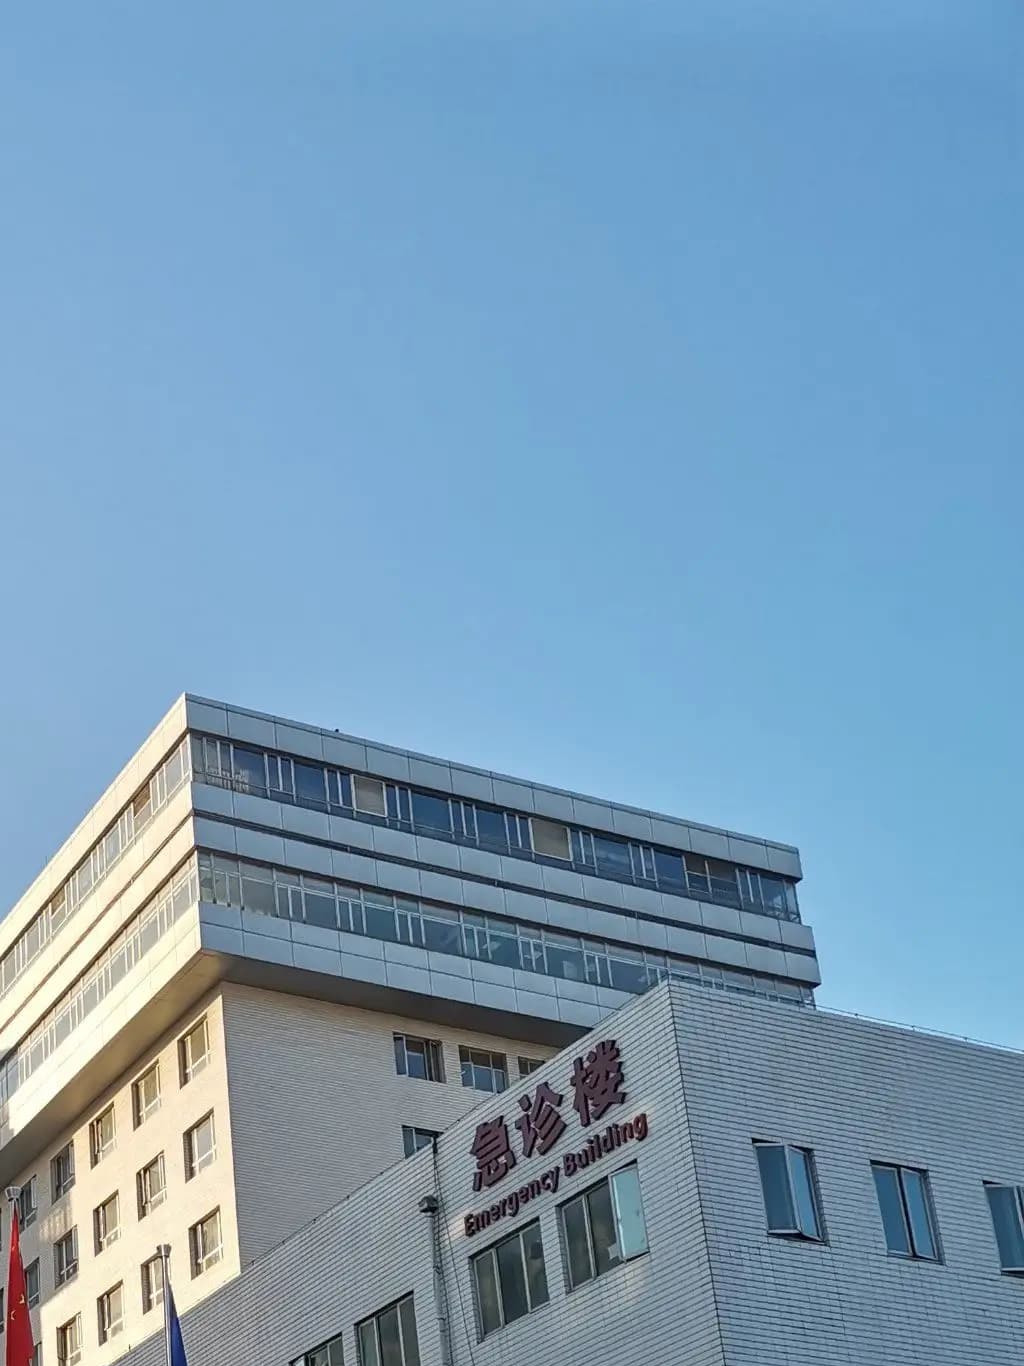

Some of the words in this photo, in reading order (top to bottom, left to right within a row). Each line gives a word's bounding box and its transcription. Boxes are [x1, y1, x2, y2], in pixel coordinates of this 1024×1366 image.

[464, 1166, 560, 1237] Emergency
[563, 1113, 649, 1177] Building
[470, 1039, 628, 1191] 急诊楼
